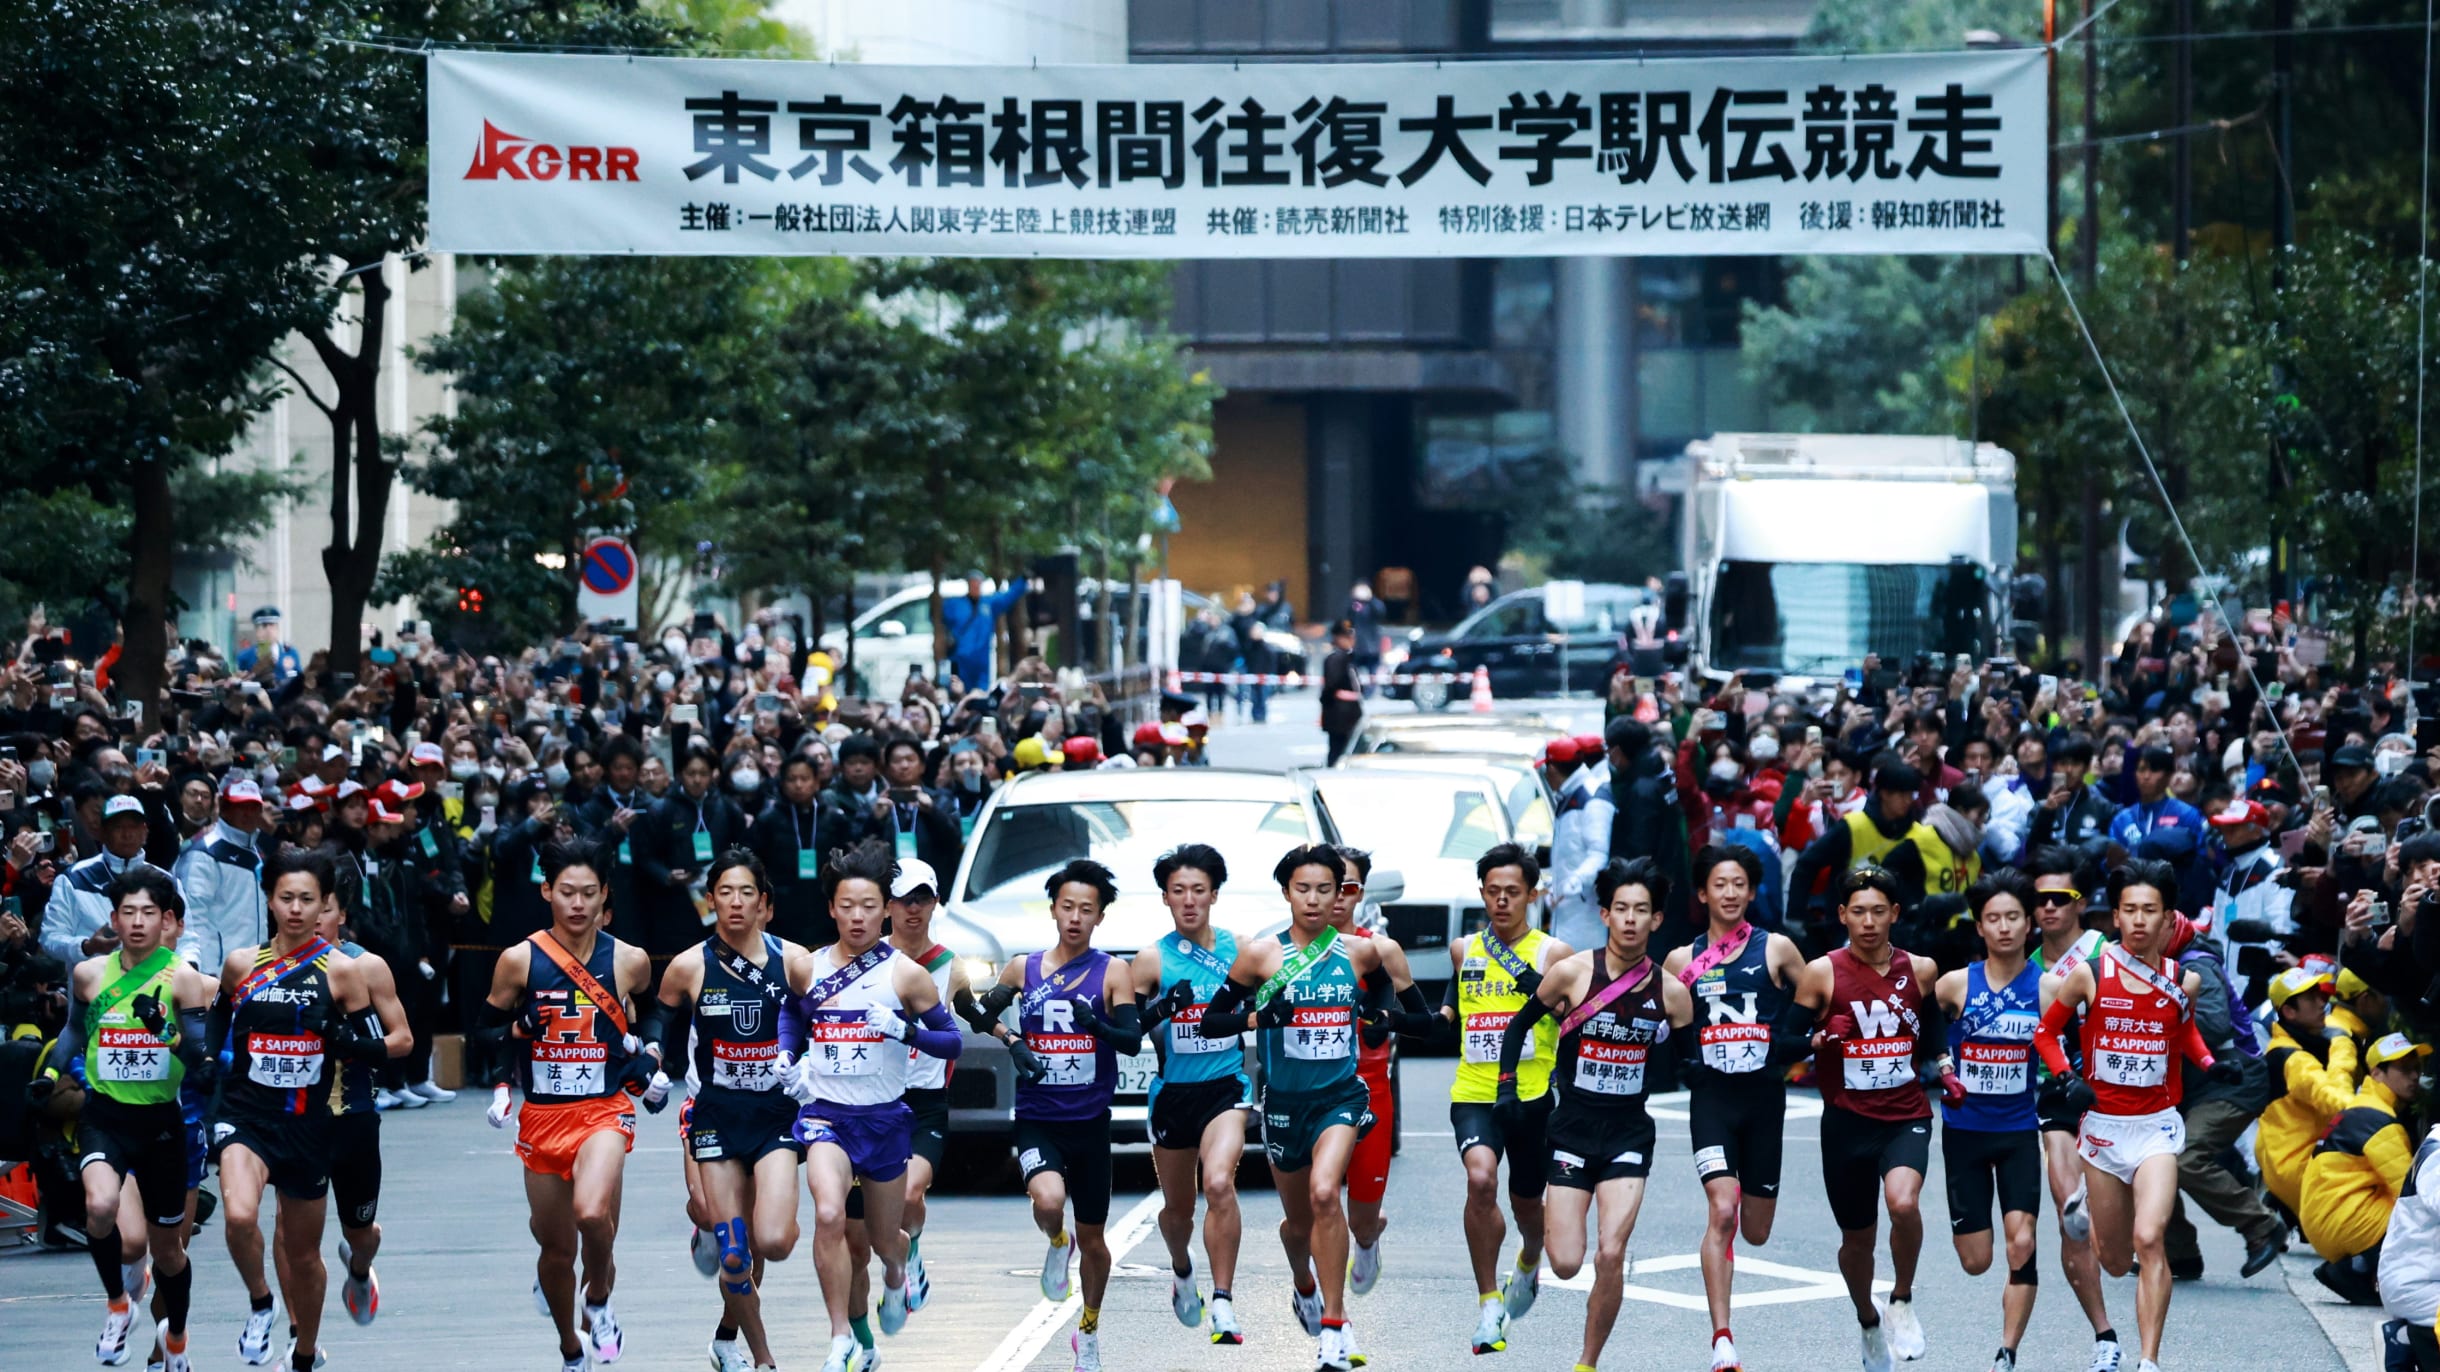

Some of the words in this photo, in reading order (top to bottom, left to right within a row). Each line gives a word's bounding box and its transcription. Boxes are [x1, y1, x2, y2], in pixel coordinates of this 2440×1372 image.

[683, 83, 2003, 189] 東京箱根間往復大学駅伝競走
[680, 201, 1177, 236] 主催：一般社団法人関東学生陸上競技連盟
[1206, 202, 1410, 236] 共催：読売新聞社
[1440, 202, 1770, 234] 特別後援：日本テレビ放送網
[1799, 200, 2006, 232] 後援：報知新聞社
[1283, 983, 1354, 1003] 青山学院
[1042, 999, 1075, 1033] R
[1705, 992, 1758, 1026] N
[542, 1005, 598, 1043] H
[1301, 1011, 1351, 1024] SAPPORO
[1849, 1000, 1900, 1039] W
[2105, 1016, 2164, 1034] 帝京大学
[1296, 1029, 1346, 1046] 青学大
[1716, 1026, 1768, 1040] SAPPORO
[265, 1038, 321, 1053] SAPPORO
[1038, 1038, 1093, 1050] SAPPORO
[1193, 1040, 1224, 1052] 13-1
[1716, 1042, 1757, 1059] 日大
[1861, 1041, 1912, 1055] SAPPORO
[2112, 1037, 2166, 1051] SAPPORO
[108, 1049, 158, 1066] 大東大
[548, 1047, 606, 1060] SAPPORO
[825, 1044, 868, 1061] 駒大
[1312, 1046, 1335, 1058] 1-1
[1596, 1047, 1646, 1060] SAPPORO
[1975, 1047, 2027, 1060] SAPPORO
[260, 1057, 312, 1073] 創価大
[724, 1061, 774, 1078] 東洋大
[833, 1062, 857, 1074] 2-1
[1859, 1058, 1904, 1075] 早大
[2106, 1053, 2156, 1072] 帝京大
[115, 1067, 152, 1079] 10-16
[547, 1063, 592, 1081] 法大
[1966, 1063, 2022, 1080] 神奈川大
[2118, 1072, 2143, 1084] 9-1
[273, 1074, 298, 1086] 8-1
[734, 1079, 765, 1091] 4-11
[1596, 1079, 1626, 1093] 5-15
[1871, 1076, 1895, 1088] 7-1
[1979, 1081, 2008, 1092] 19-1
[553, 1081, 584, 1094] 6-11
